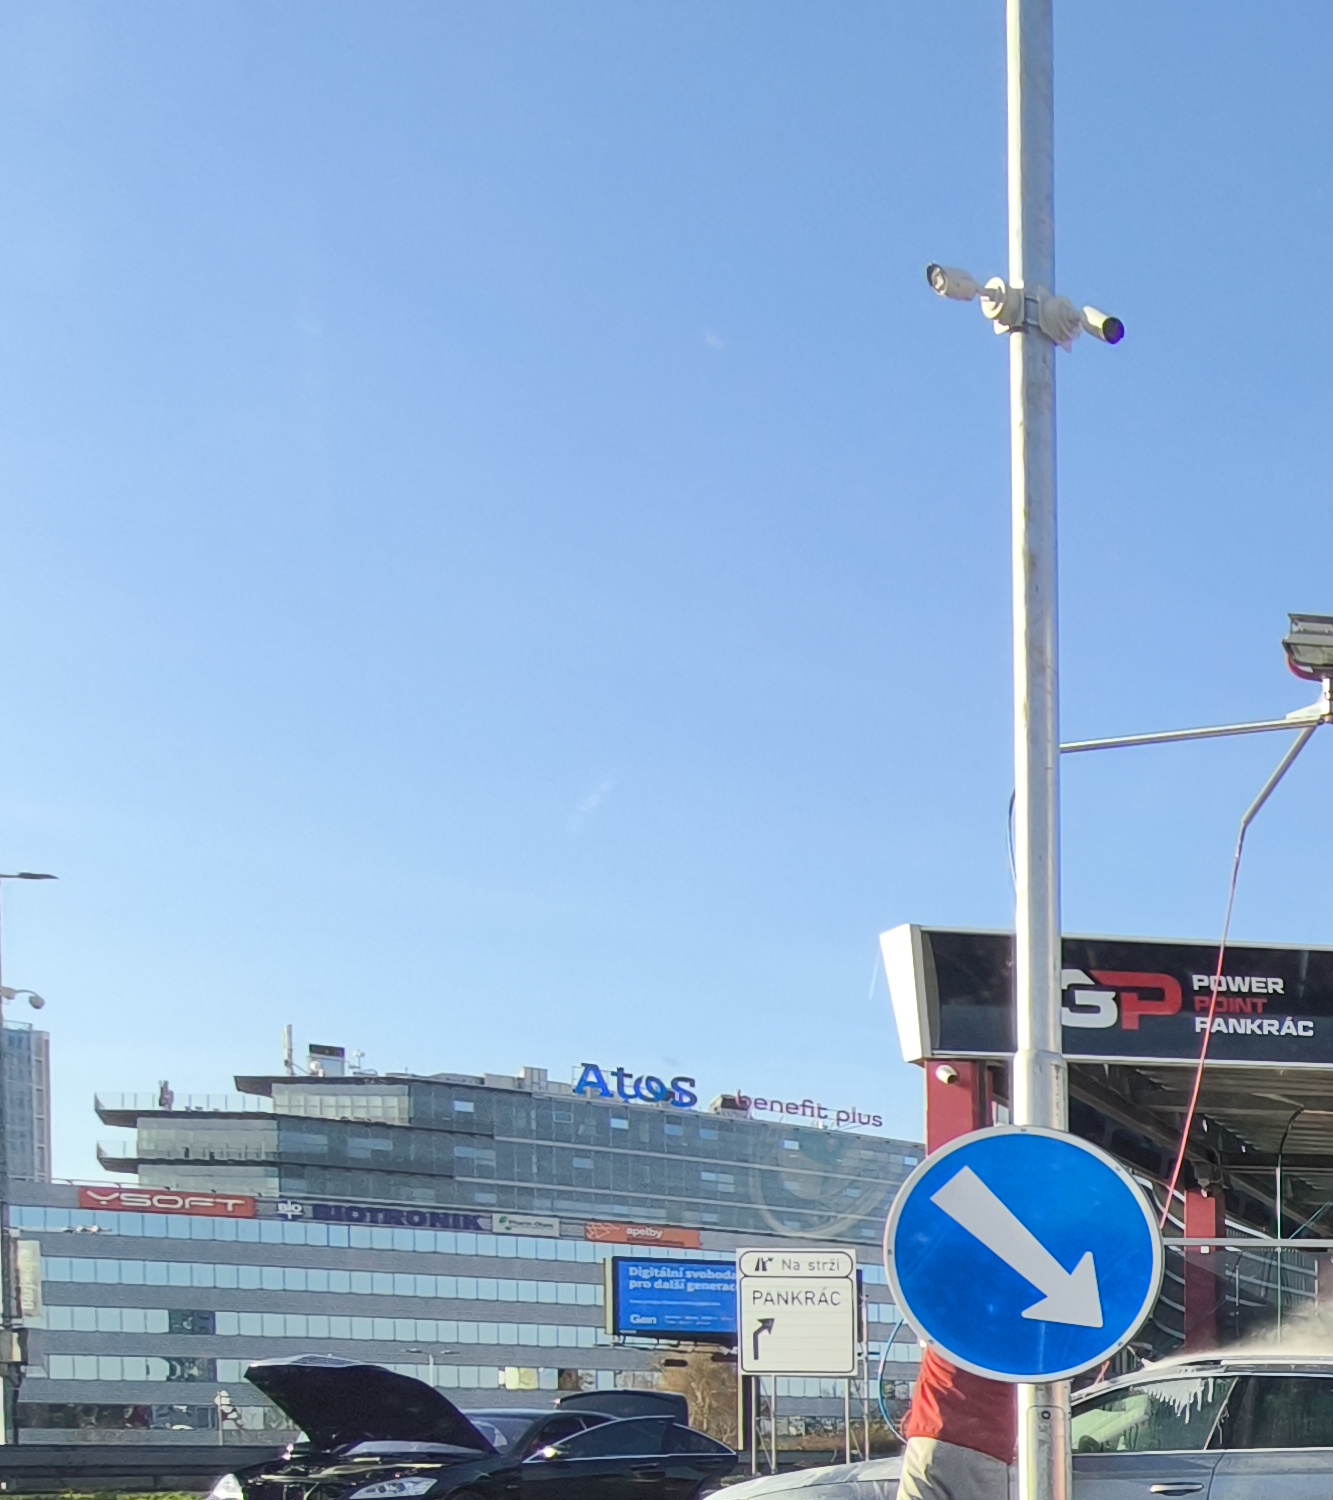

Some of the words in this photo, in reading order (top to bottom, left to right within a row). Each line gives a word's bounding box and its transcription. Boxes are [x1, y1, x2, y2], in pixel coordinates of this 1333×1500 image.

[1192, 974, 1285, 995] POWER
[1194, 995, 1268, 1014] POINT
[1195, 1016, 1315, 1037] PANKRÁC
[572, 1062, 698, 1108] Atos
[735, 1089, 829, 1120] benefit
[835, 1106, 884, 1128] plus
[87, 1190, 246, 1212] YSOFT
[626, 1227, 663, 1239] apelby
[629, 1266, 684, 1279] Digitální
[782, 1259, 800, 1271] Na
[808, 1259, 840, 1271] strži
[629, 1280, 651, 1290] pro
[654, 1279, 685, 1289] další
[752, 1287, 841, 1306] PANKRÁC
